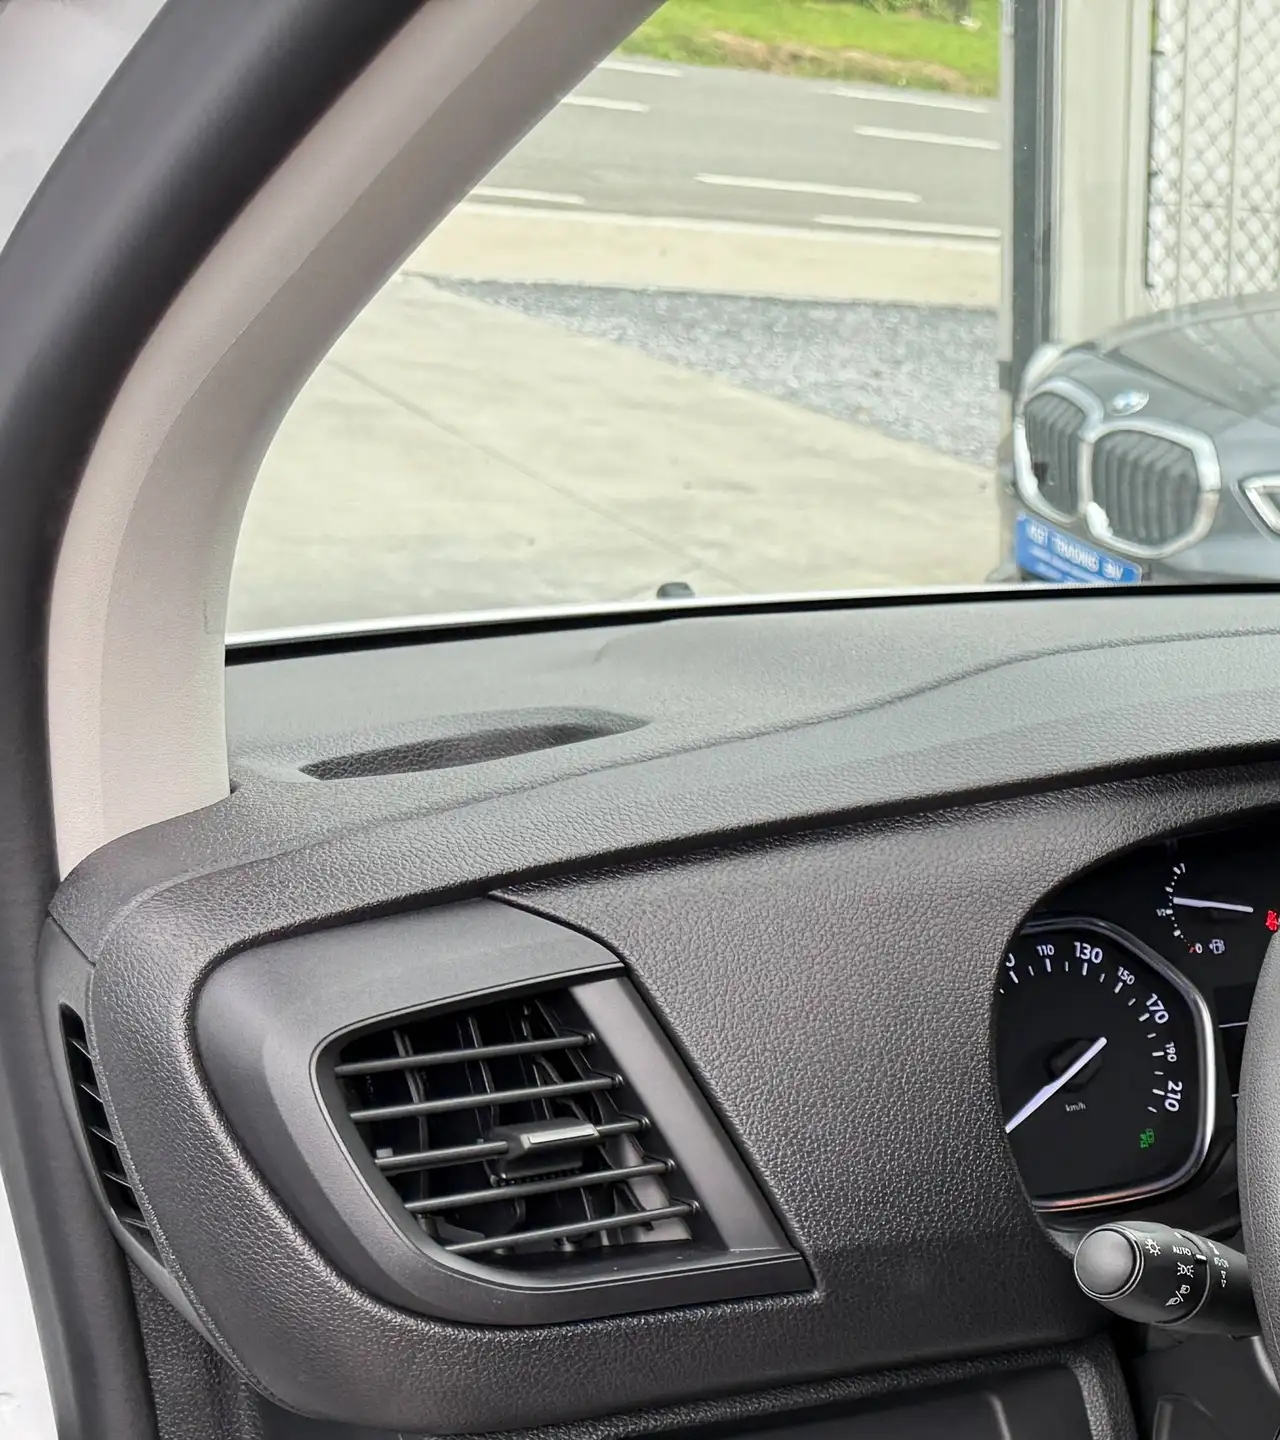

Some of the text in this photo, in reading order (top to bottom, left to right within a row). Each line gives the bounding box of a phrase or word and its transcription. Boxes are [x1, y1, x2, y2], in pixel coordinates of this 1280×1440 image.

[1036, 944, 1055, 956] 110
[1073, 941, 1103, 964] 130
[1195, 943, 1203, 954] 0
[1117, 966, 1135, 985] 150
[1145, 993, 1169, 1024] 170
[1165, 1041, 1178, 1062] 190
[1164, 1080, 1183, 1112] 210
[1065, 1101, 1087, 1112] km/h
[1173, 1246, 1192, 1256] AUTO
